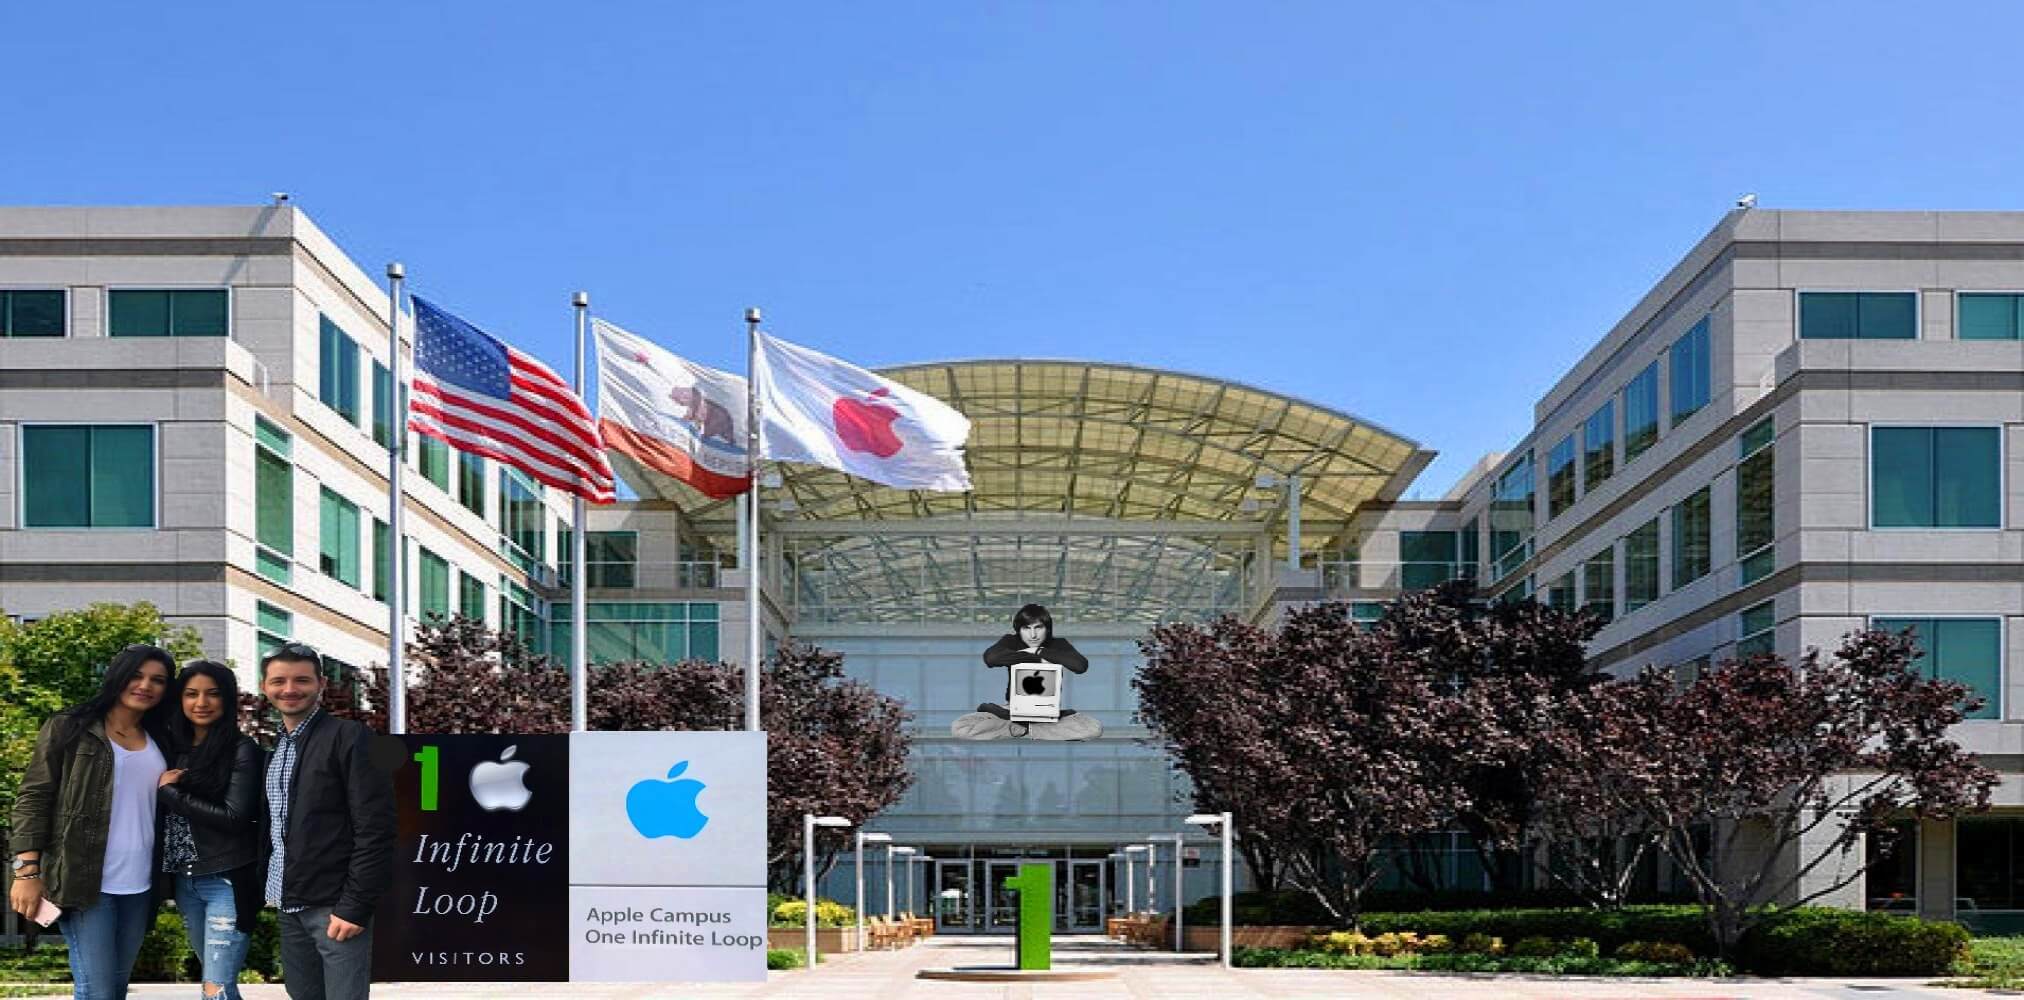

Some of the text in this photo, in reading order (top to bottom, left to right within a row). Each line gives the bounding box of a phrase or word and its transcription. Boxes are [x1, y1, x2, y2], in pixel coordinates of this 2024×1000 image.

[414, 745, 438, 811] 1
[412, 832, 553, 872] Infinite
[412, 886, 498, 923] Loop
[586, 906, 732, 926] Apple Campus
[1004, 862, 1051, 970] 1
[585, 929, 763, 950] One Infinite Loop
[411, 952, 525, 965] VISITORS
